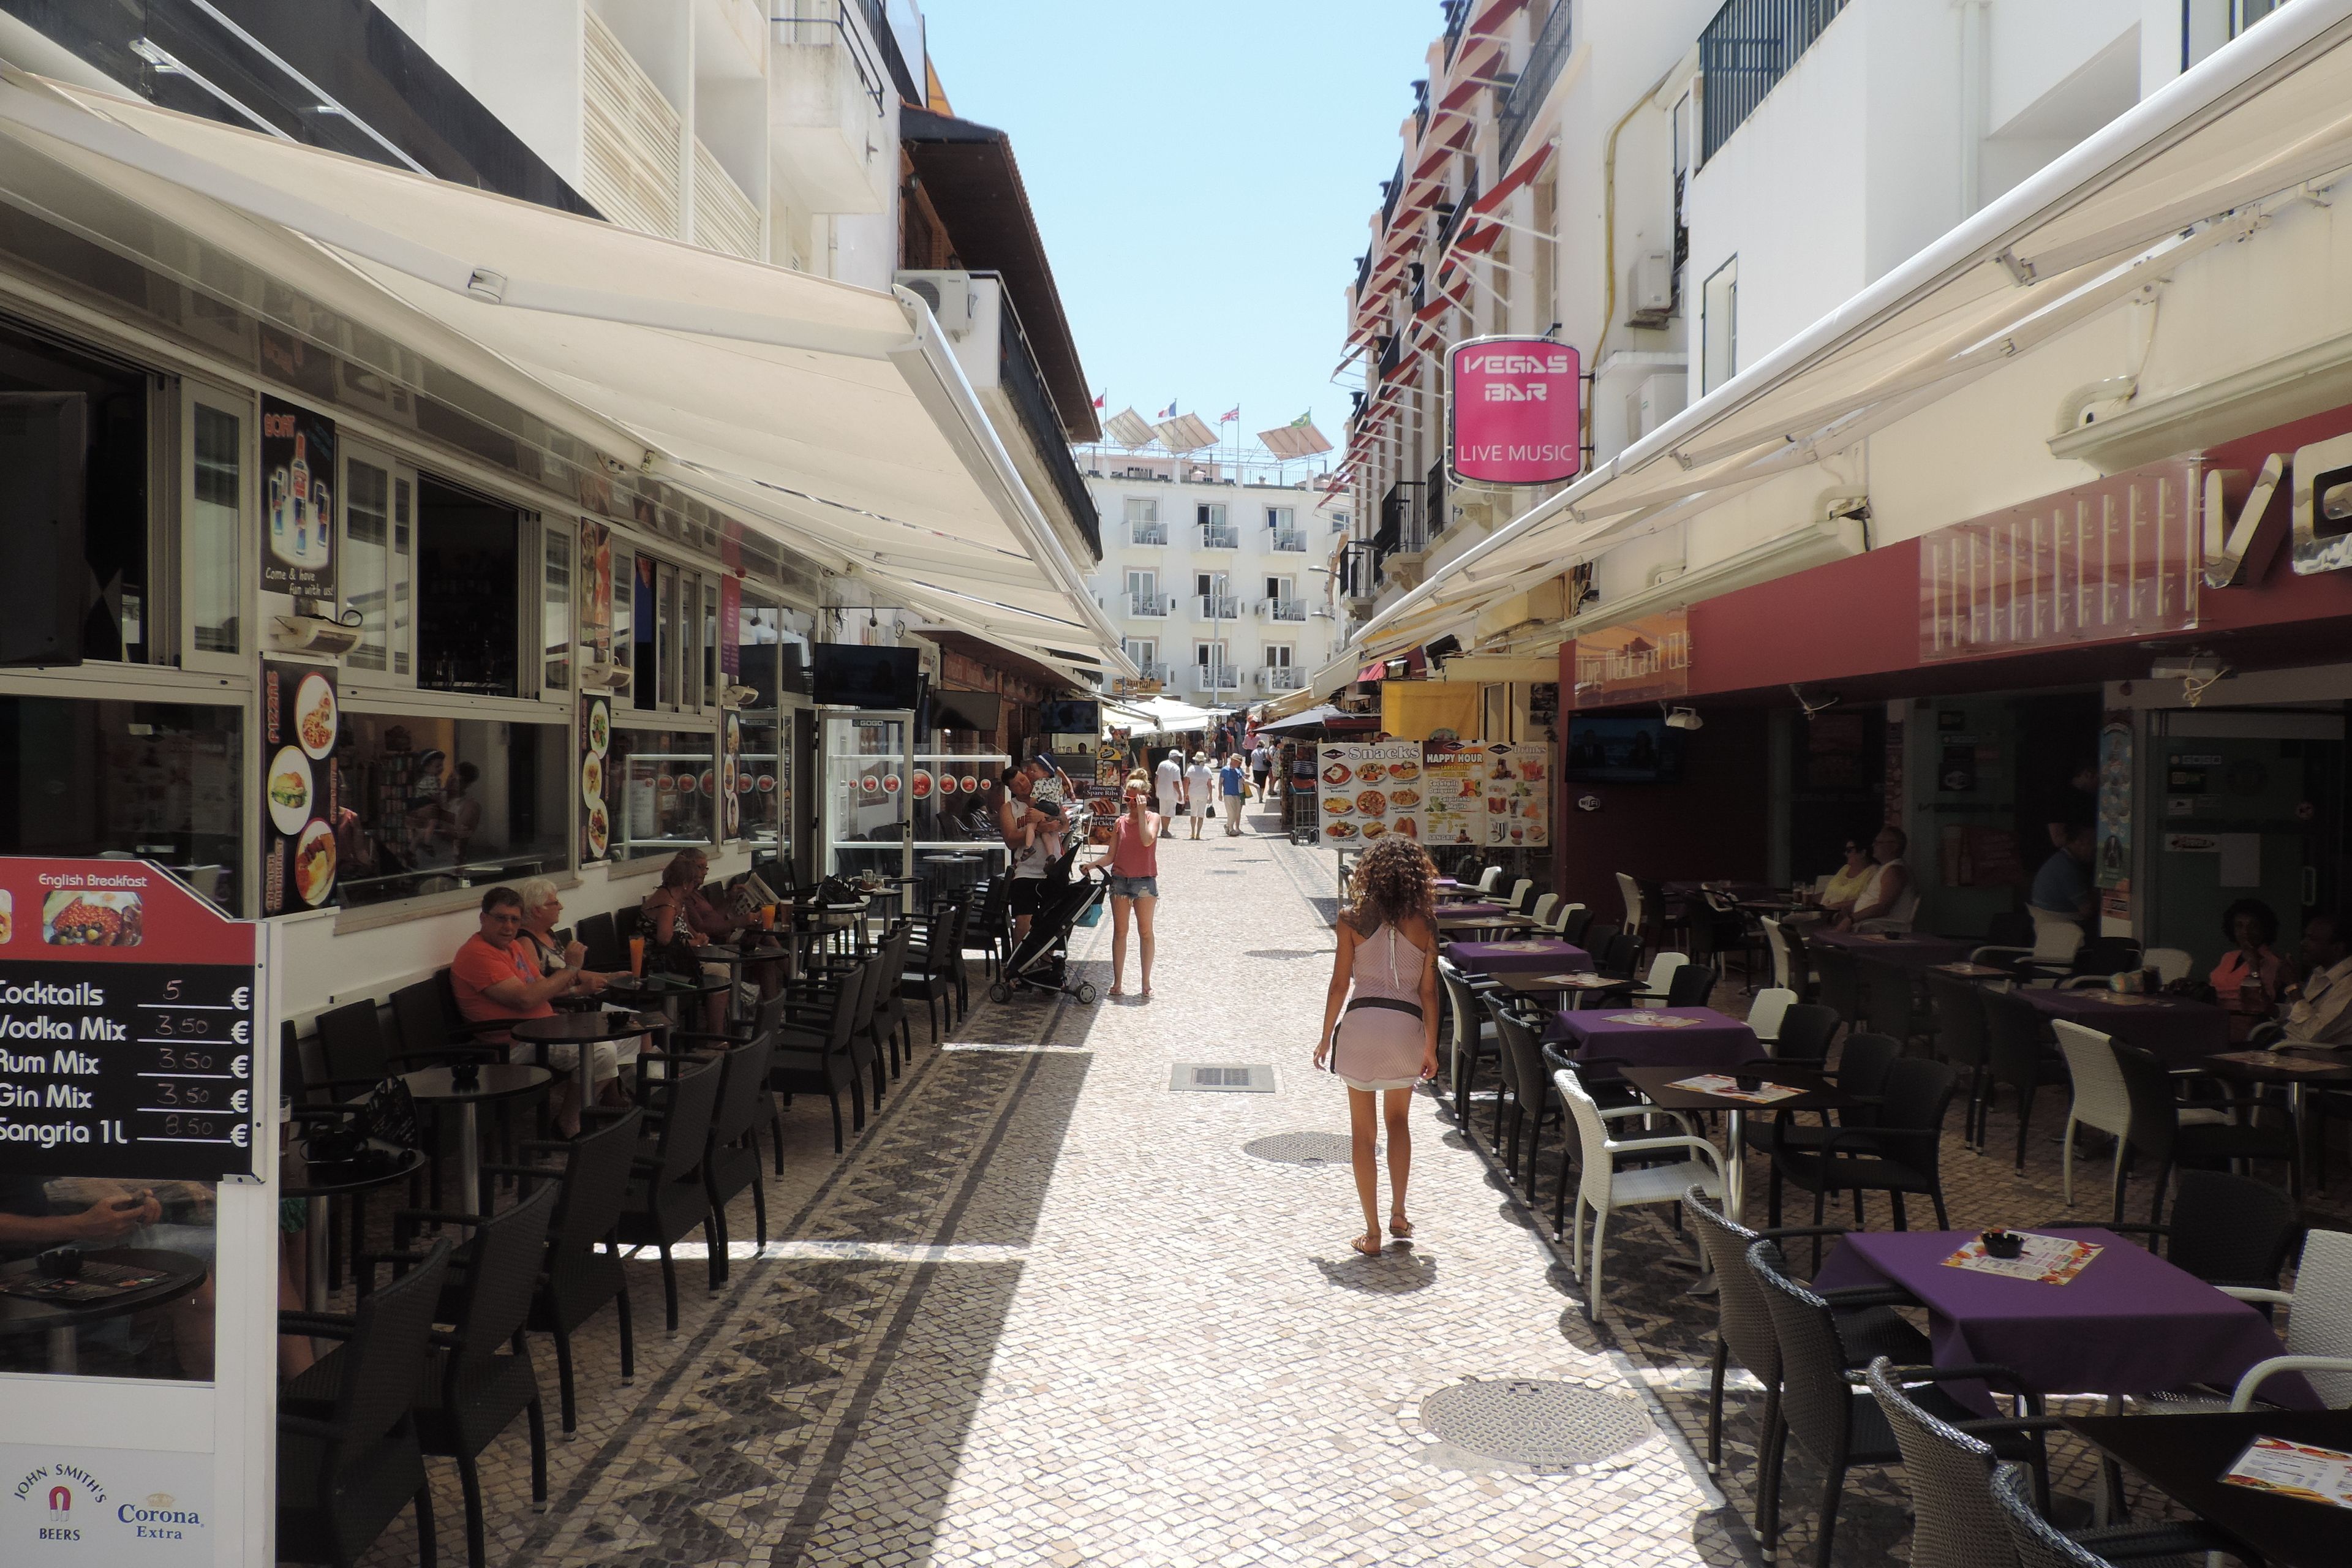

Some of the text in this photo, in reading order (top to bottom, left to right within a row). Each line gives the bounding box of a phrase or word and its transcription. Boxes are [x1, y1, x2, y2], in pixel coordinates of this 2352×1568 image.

[1464, 355, 1568, 374] VEGAS
[1484, 383, 1547, 402] BAR
[1460, 444, 1573, 462] LIVE MUSIC
[265, 567, 316, 582] Come & have
[289, 582, 302, 595] fun
[304, 582, 322, 596] with
[268, 670, 279, 744] PIZZAS
[1348, 746, 1420, 760] Snacks
[1427, 754, 1483, 763] HAPPY HOUR
[1513, 745, 1547, 754] Drinks
[39, 873, 148, 889] English Breakfast
[162, 980, 183, 1000] 5
[231, 986, 249, 1011] €
[80, 1016, 126, 1041] Mix
[231, 1020, 249, 1044] €
[0, 1050, 45, 1074] Rum
[53, 1050, 99, 1075] Mix
[230, 1055, 249, 1079] €
[0, 1084, 39, 1108] Gin
[46, 1084, 92, 1109] Mix
[230, 1089, 249, 1113] €
[100, 1119, 128, 1145] 1L
[230, 1123, 248, 1148] €
[14, 1463, 107, 1504] JOHN SMITH'S
[118, 1503, 200, 1525] Corona
[39, 1528, 80, 1541] BEERS
[137, 1525, 183, 1540] Extra
